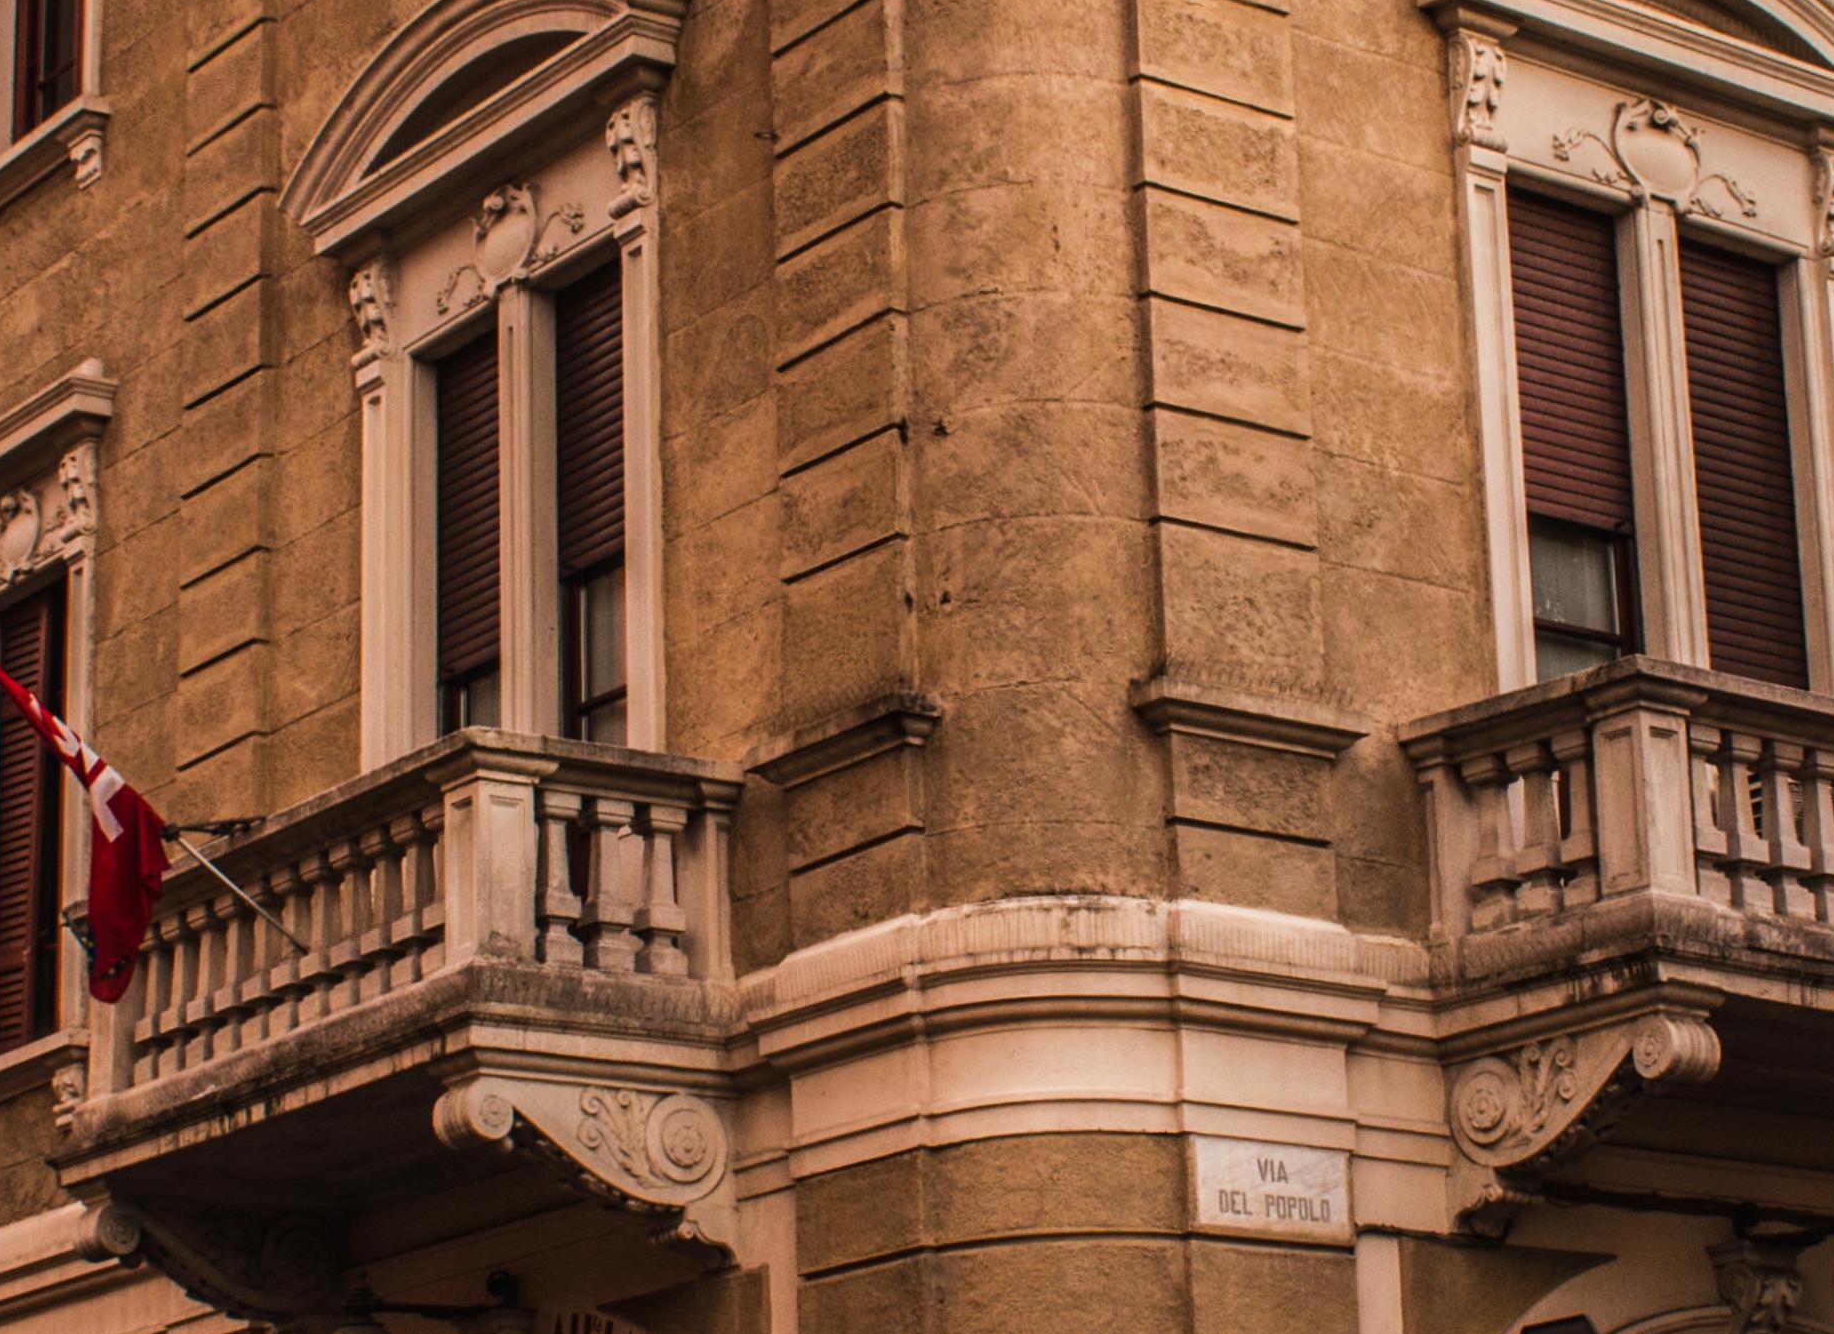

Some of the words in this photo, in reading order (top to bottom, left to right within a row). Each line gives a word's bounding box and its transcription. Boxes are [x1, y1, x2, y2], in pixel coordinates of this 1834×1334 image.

[1256, 1157, 1290, 1185] VIA
[1218, 1188, 1254, 1217] DEL
[1264, 1193, 1332, 1224] POPOLO
